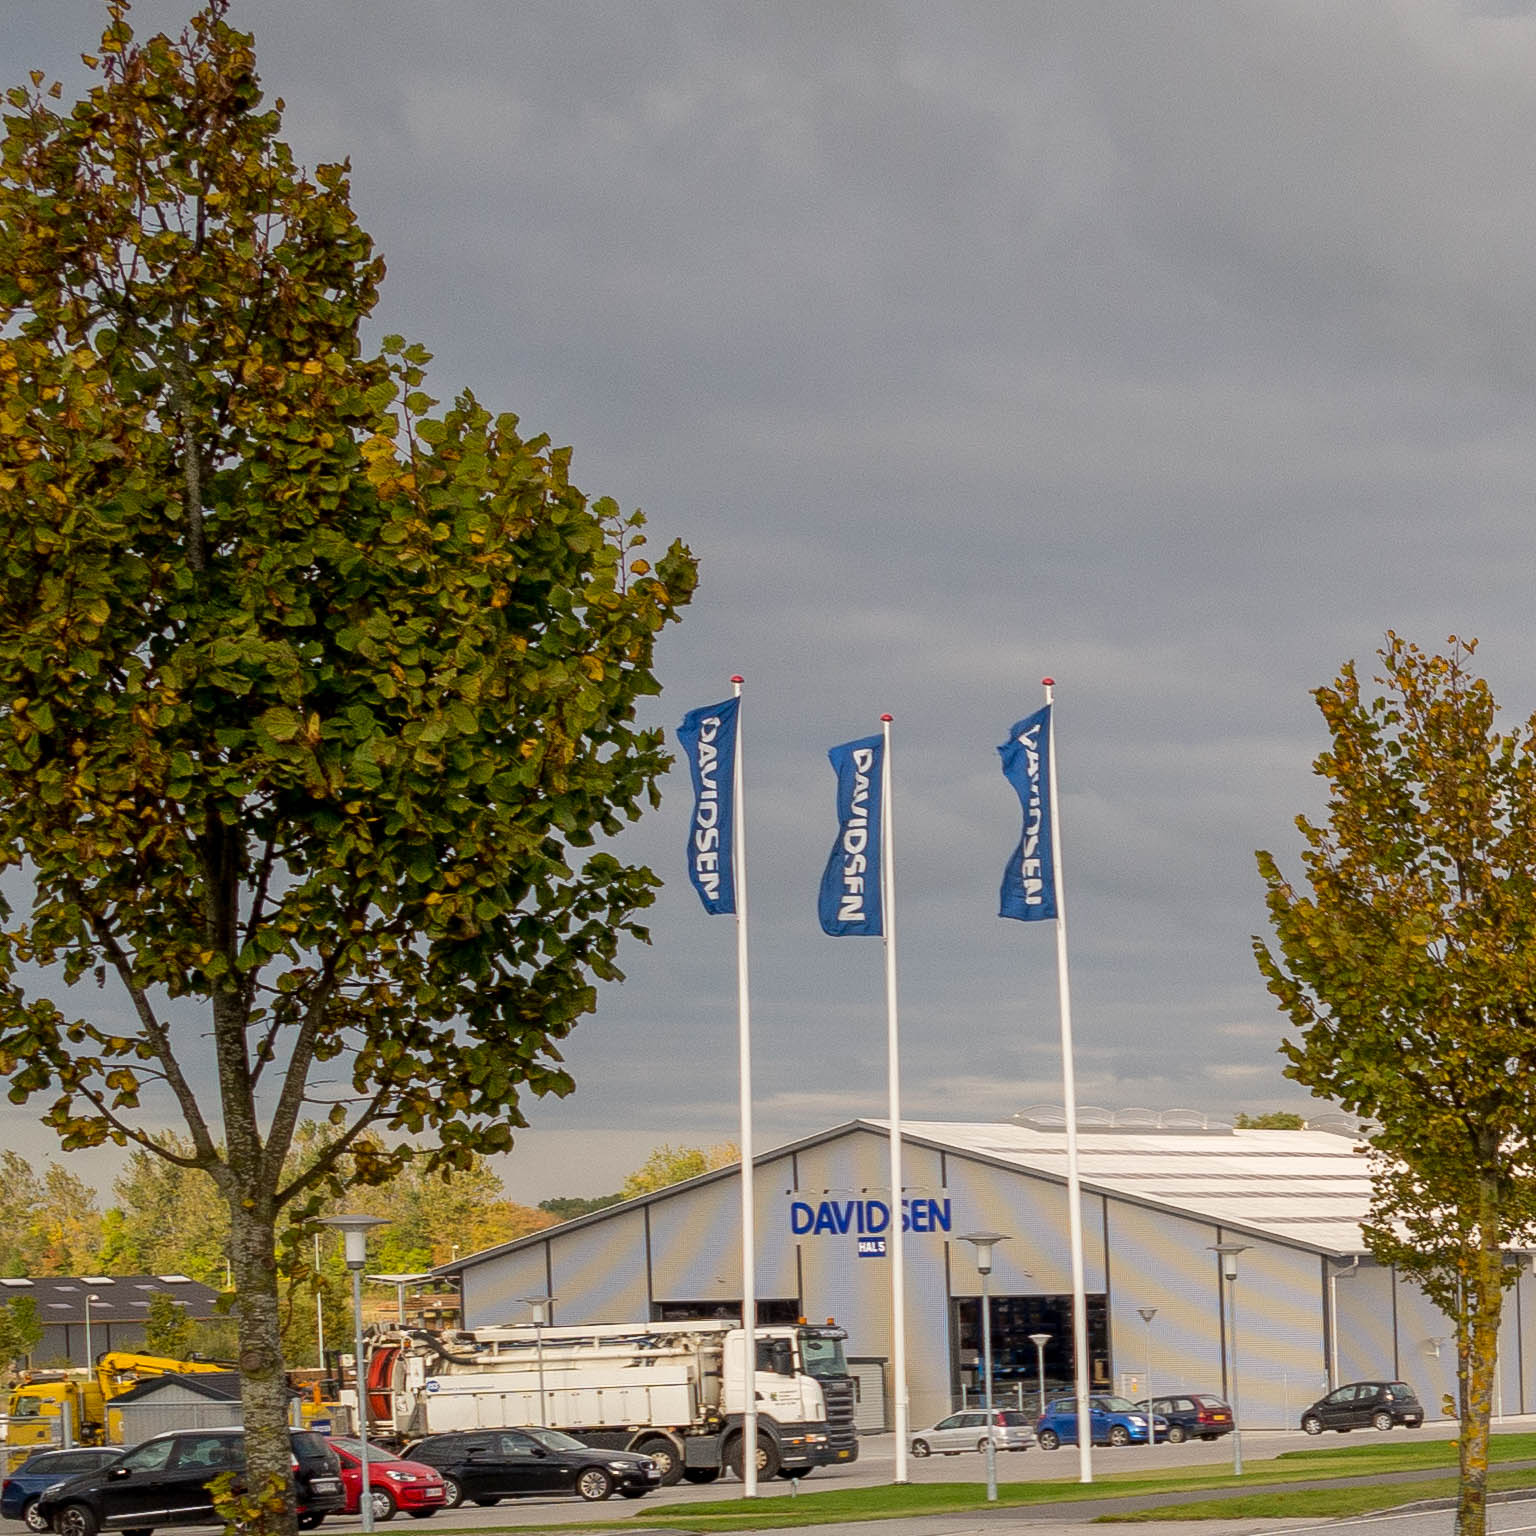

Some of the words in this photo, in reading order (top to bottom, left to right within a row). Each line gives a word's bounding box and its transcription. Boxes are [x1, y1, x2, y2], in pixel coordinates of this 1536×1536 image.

[696, 716, 721, 901] DAVIDSEN
[790, 1198, 952, 1235] DAVIDSEN
[858, 1241, 877, 1252] HAL
